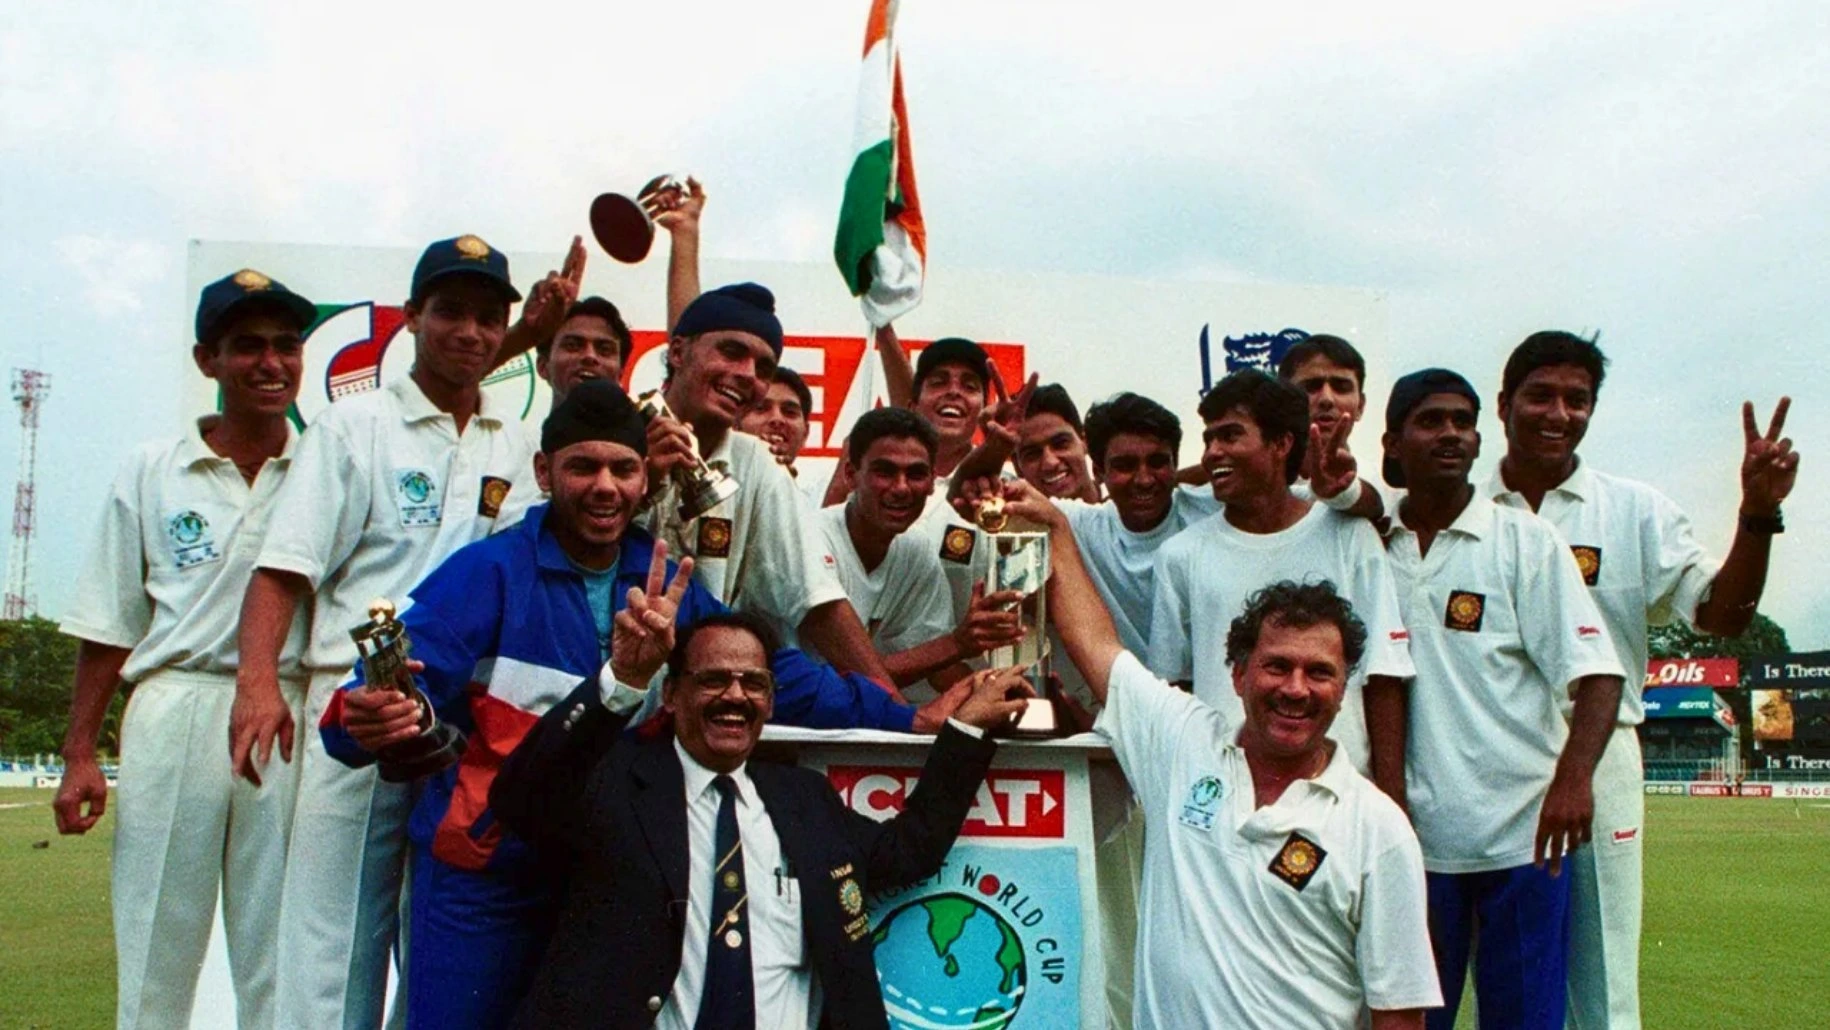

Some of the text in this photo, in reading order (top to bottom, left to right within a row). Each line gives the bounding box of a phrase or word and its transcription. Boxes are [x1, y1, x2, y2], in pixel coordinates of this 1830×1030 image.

[628, 345, 978, 449] EA
[1660, 662, 1705, 683] Oils
[1764, 664, 1830, 679] Is There
[1766, 755, 1830, 769] Is There
[852, 774, 1041, 828] CAT
[962, 864, 1044, 927] WORLD
[1036, 938, 1065, 984] CUP
